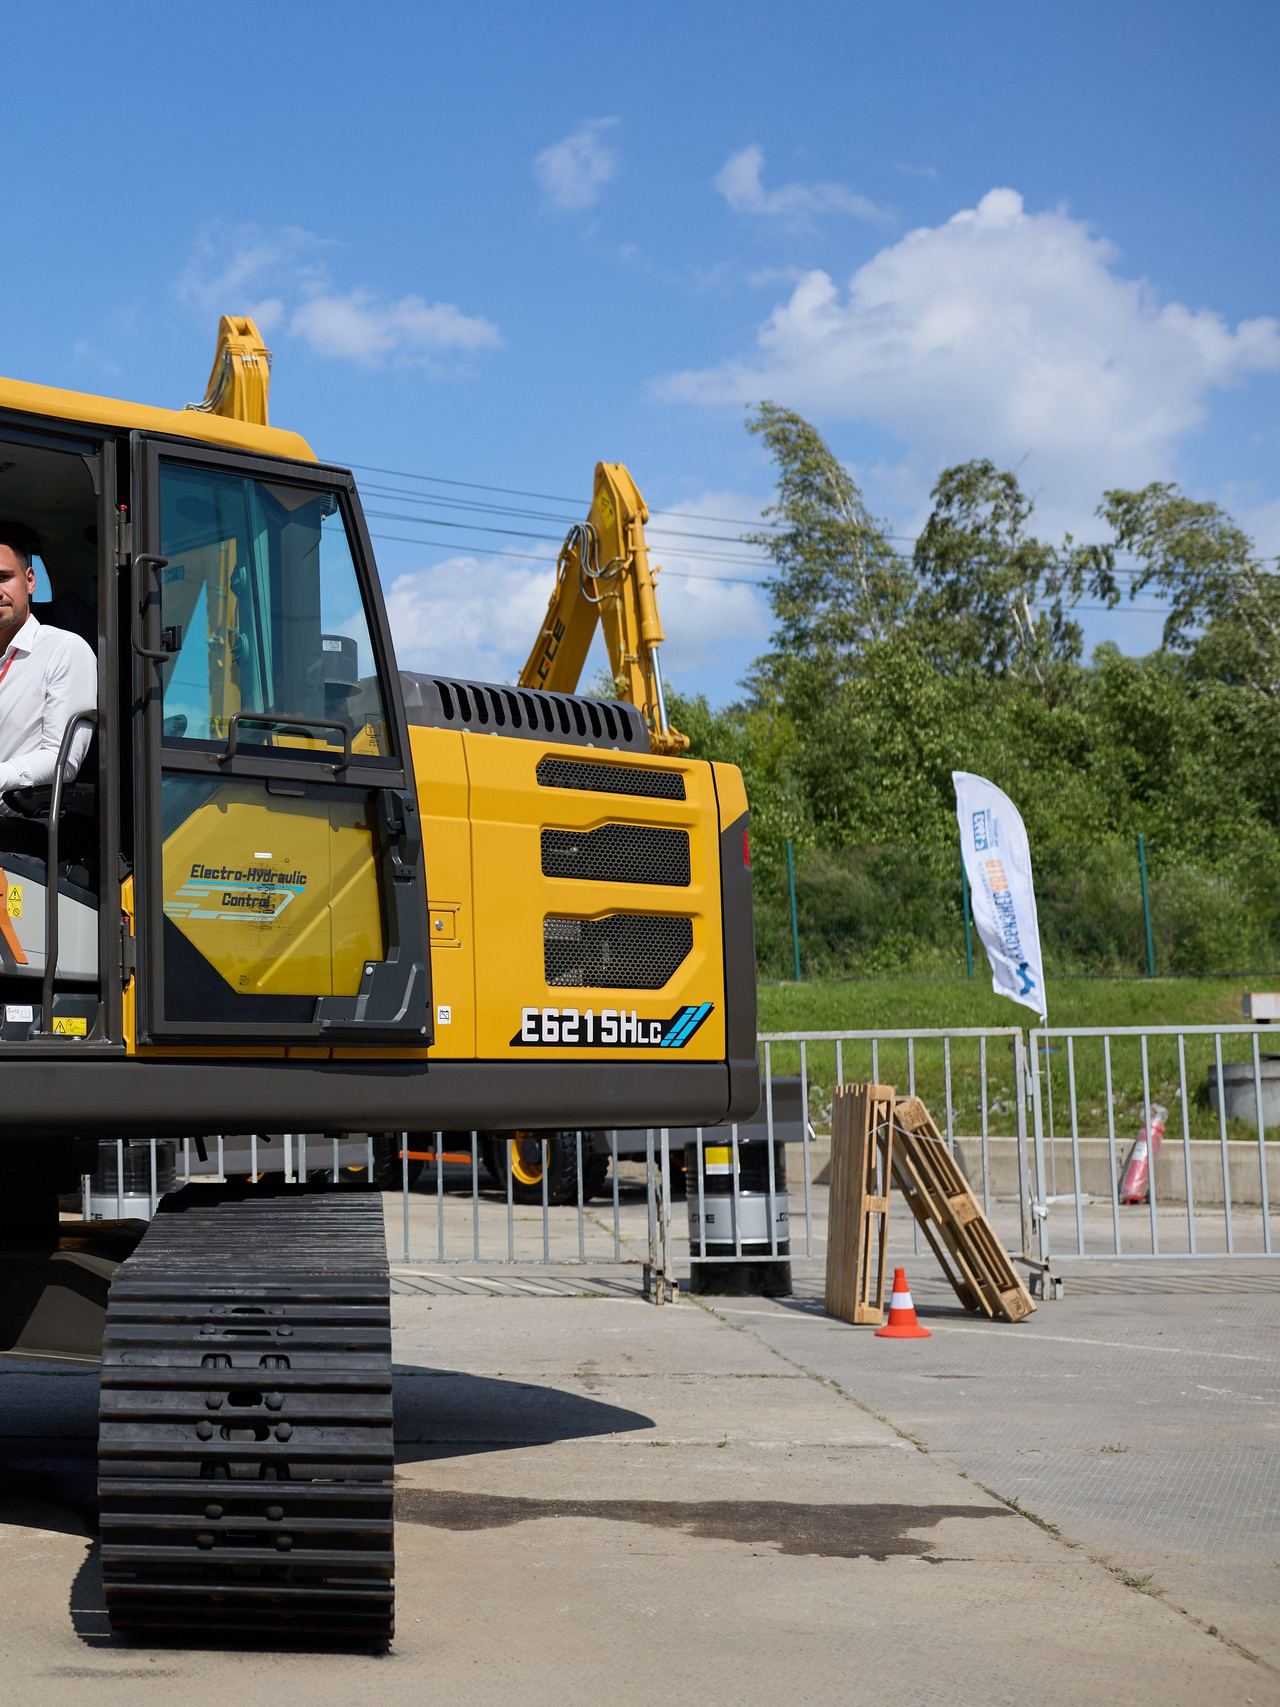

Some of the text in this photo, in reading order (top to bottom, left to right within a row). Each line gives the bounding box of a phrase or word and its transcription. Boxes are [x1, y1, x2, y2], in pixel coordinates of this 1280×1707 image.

[190, 864, 307, 885] Electro-Hydraulic
[222, 892, 271, 908] Control
[522, 1007, 662, 1043] E6215HLC
